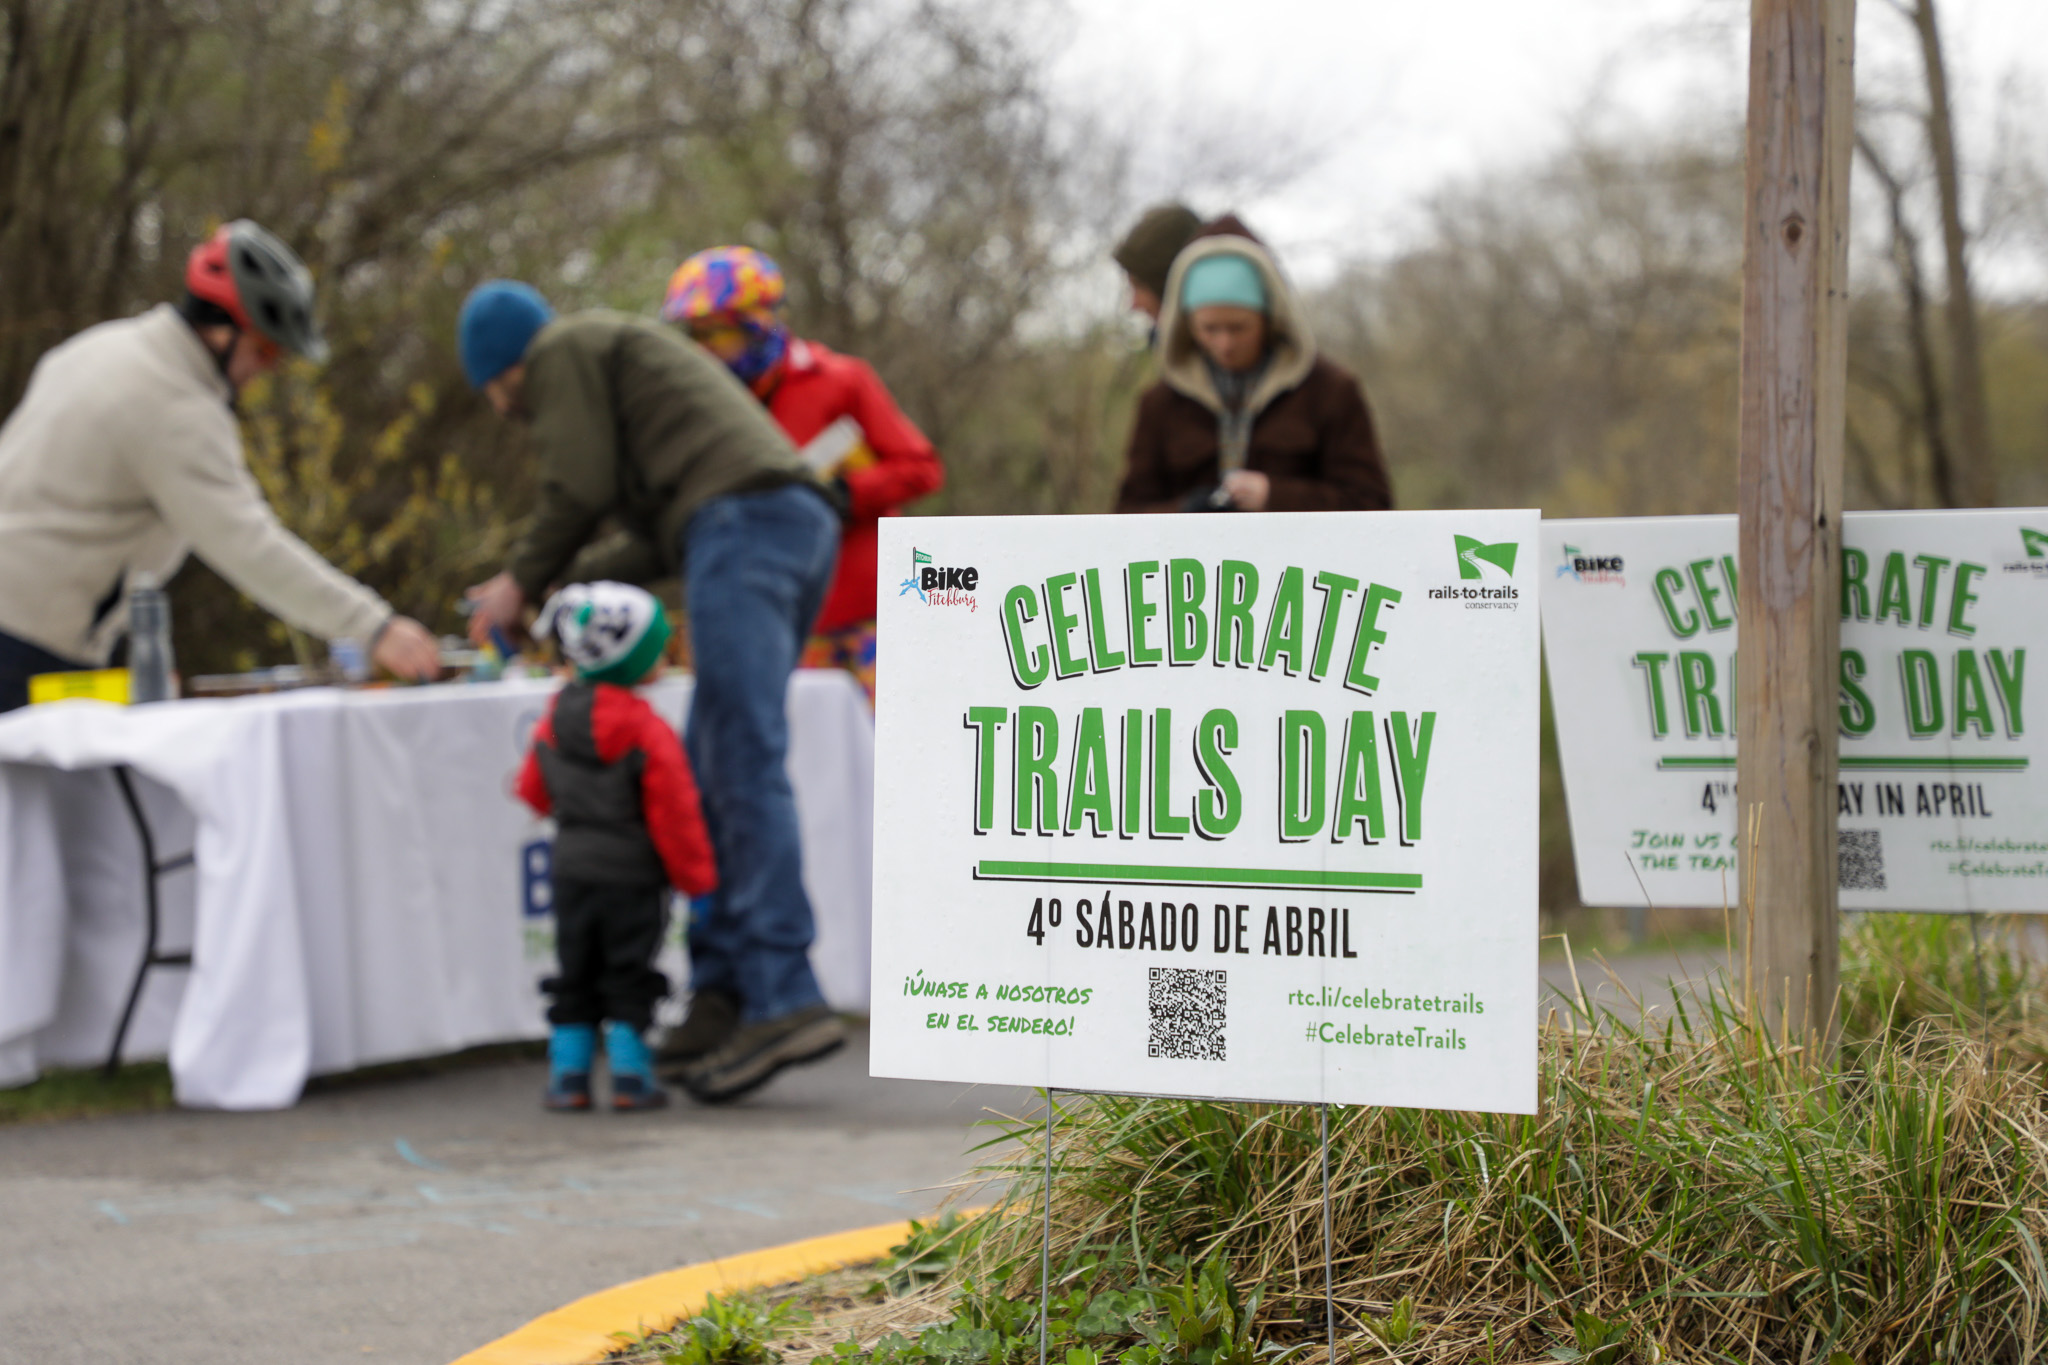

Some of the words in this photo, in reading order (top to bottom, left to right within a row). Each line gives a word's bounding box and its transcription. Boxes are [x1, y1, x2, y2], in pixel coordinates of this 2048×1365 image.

[927, 588, 978, 613] Fitchburg
[1464, 601, 1519, 612] conservancy
[1652, 547, 1988, 640] CERATE
[1000, 558, 1402, 697] CELEBRATE
[1633, 648, 1877, 741] TRS
[1898, 648, 2027, 741] DAY
[964, 706, 1242, 841] TRAILS
[1279, 709, 1437, 847] DAY
[1875, 782, 1906, 817] IN
[1916, 782, 1994, 818] APRIL
[1631, 830, 1685, 849] JOIN
[1694, 832, 1722, 849] US
[1640, 854, 1680, 870] THE
[1689, 854, 1737, 871] TRAI
[1076, 890, 1199, 952] SÁBADO
[1214, 904, 1249, 954] DE
[1263, 905, 1358, 959] ABRIL
[903, 968, 969, 999] ¡ÚNASE
[975, 983, 989, 1000] A
[996, 983, 1094, 1005] NOSOTROS
[1288, 986, 1485, 1014] rtc.li/celebratetrails
[926, 1012, 950, 1029] EN
[956, 1013, 980, 1031] EL
[987, 1015, 1075, 1037] SENDERO!
[1305, 1021, 1467, 1050] #CelebrateTrails
